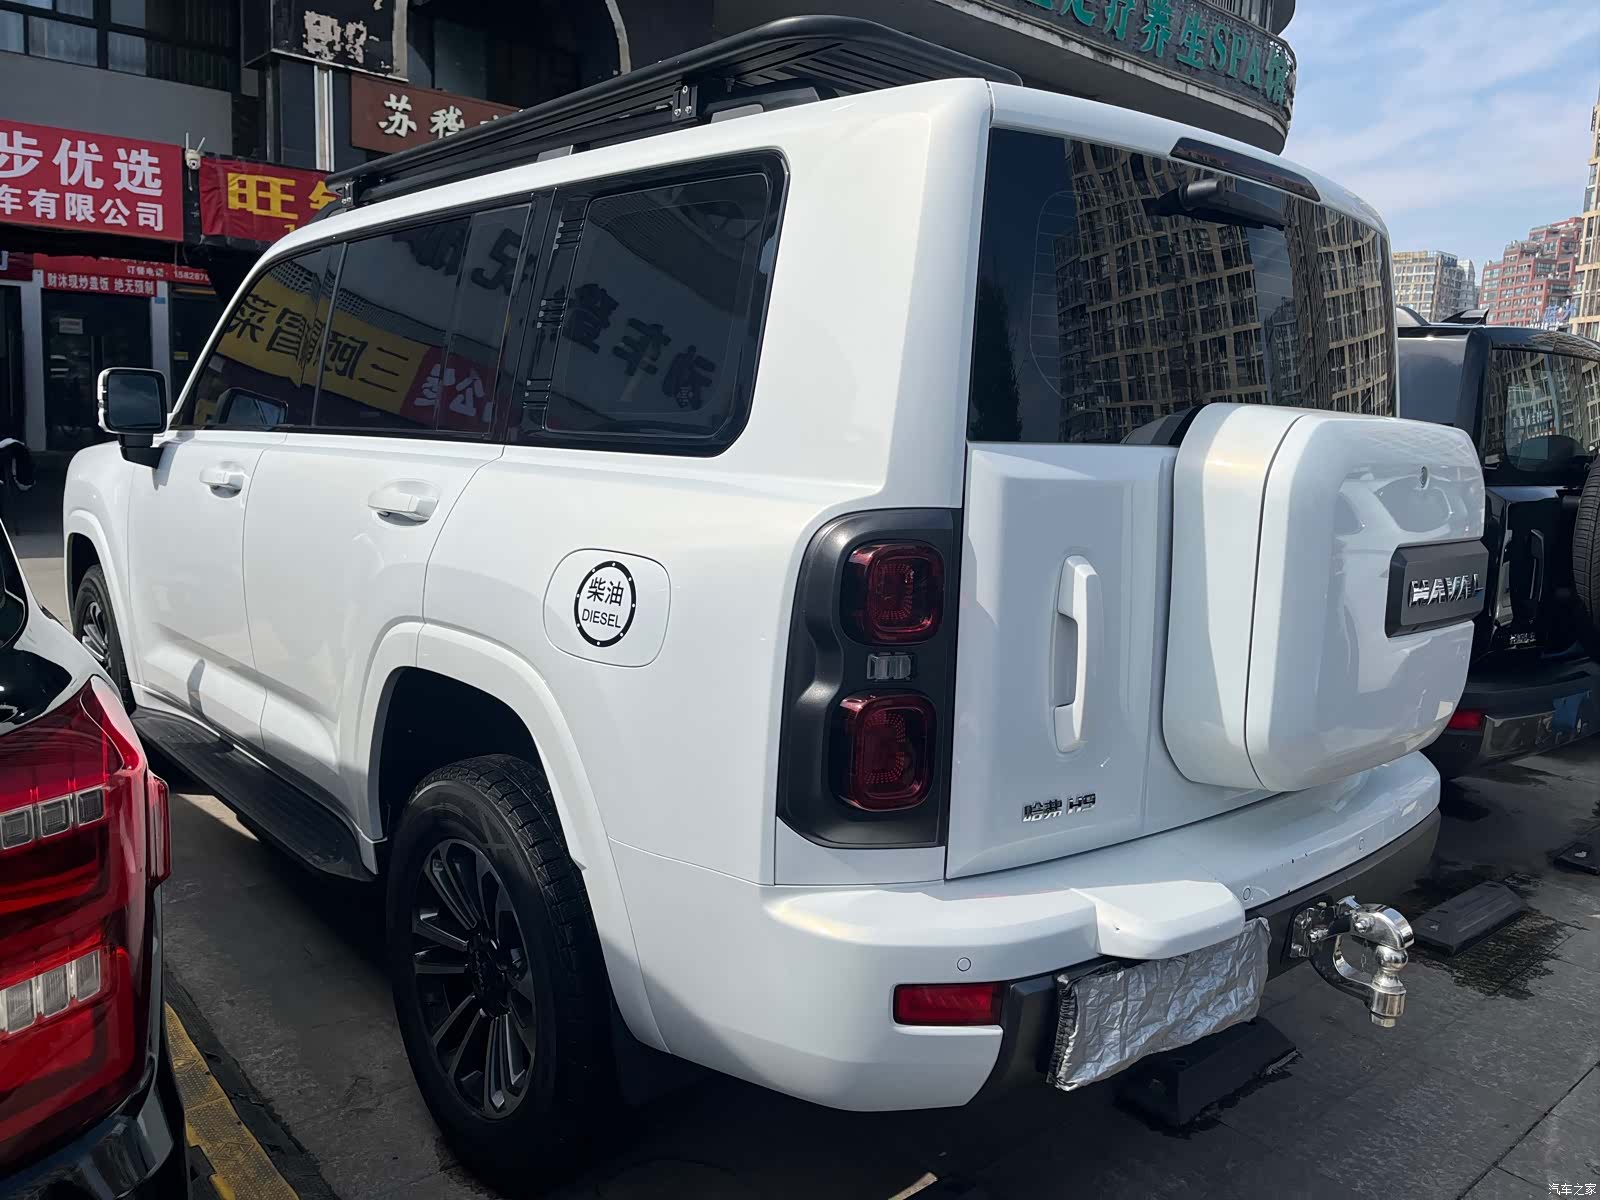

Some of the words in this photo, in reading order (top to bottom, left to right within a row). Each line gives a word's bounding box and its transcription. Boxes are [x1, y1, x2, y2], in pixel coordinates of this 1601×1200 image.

[378, 93, 499, 139] 苏稽
[0, 130, 163, 197] 步优选
[0, 184, 164, 232] 车有限公司
[587, 577, 624, 606] 柴油
[1409, 573, 1484, 608] HAVAL
[582, 608, 622, 629] DIESEL
[1022, 799, 1063, 822] 哈弗
[1066, 793, 1096, 814] H9
